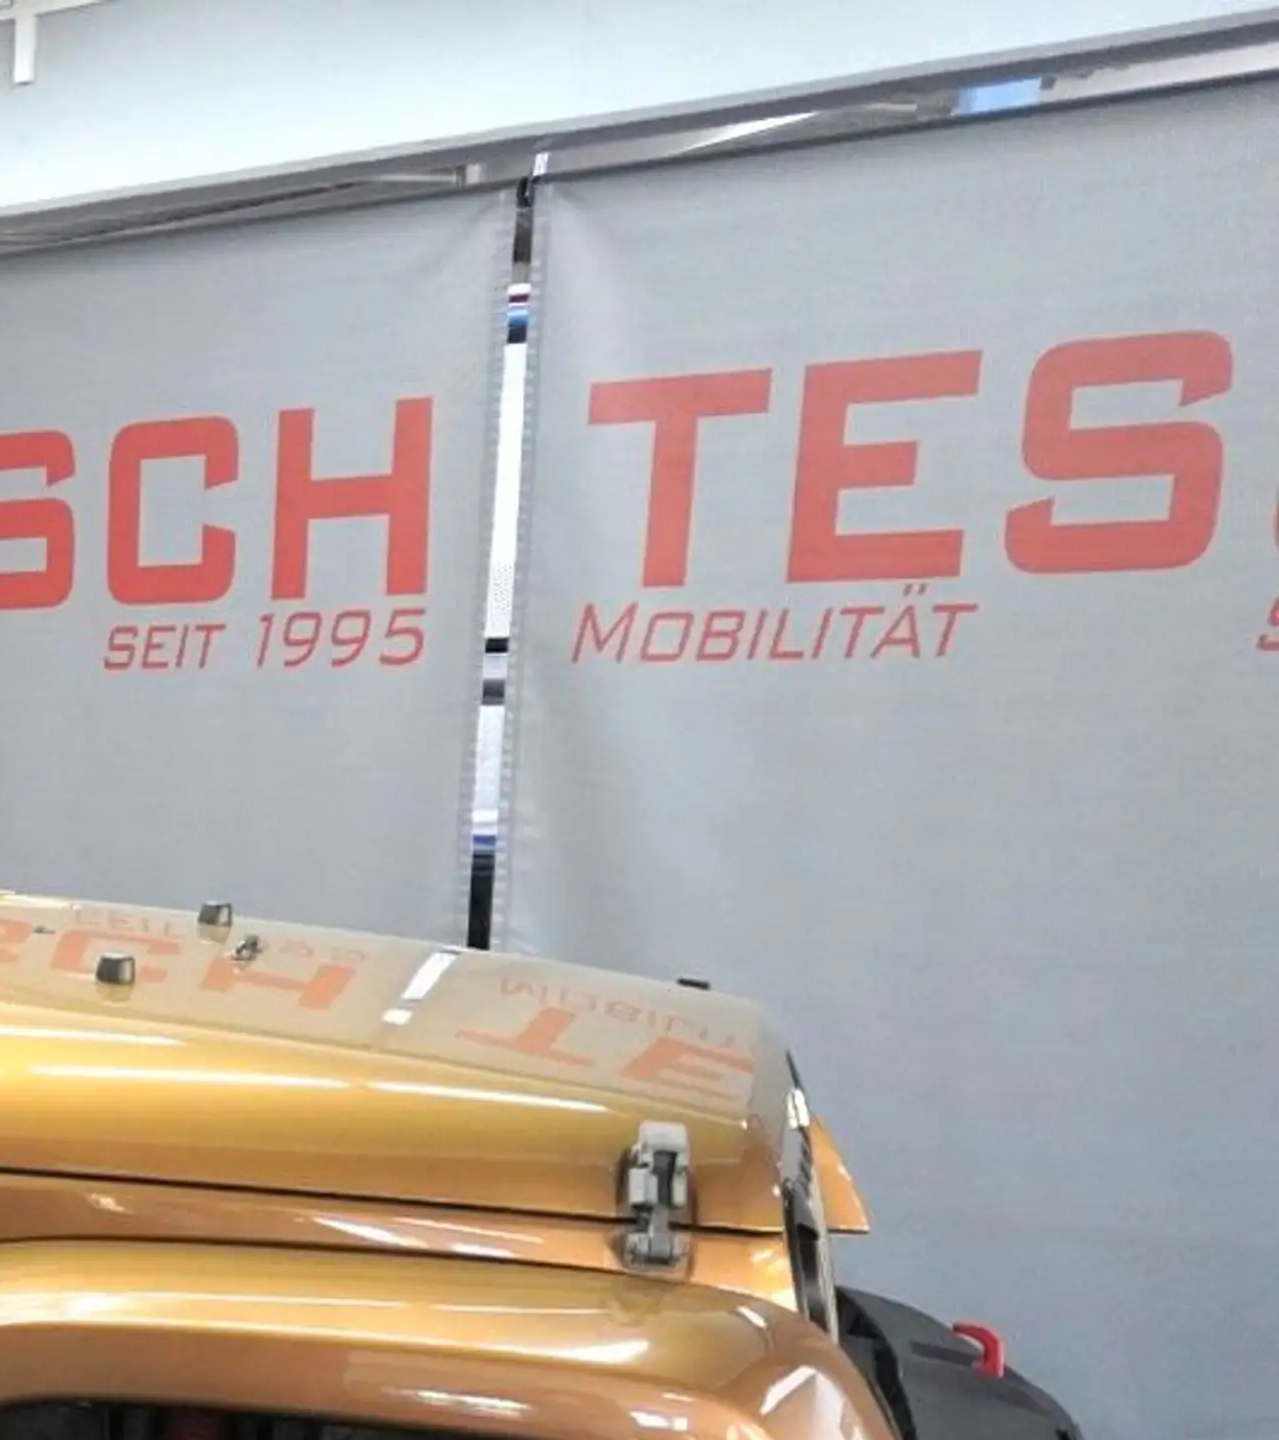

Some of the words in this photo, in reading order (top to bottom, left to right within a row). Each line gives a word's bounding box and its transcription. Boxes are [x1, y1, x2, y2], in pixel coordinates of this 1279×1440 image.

[104, 623, 227, 670] SEIT
[255, 607, 427, 669] 1995
[572, 583, 979, 663] MOBILITÄT
